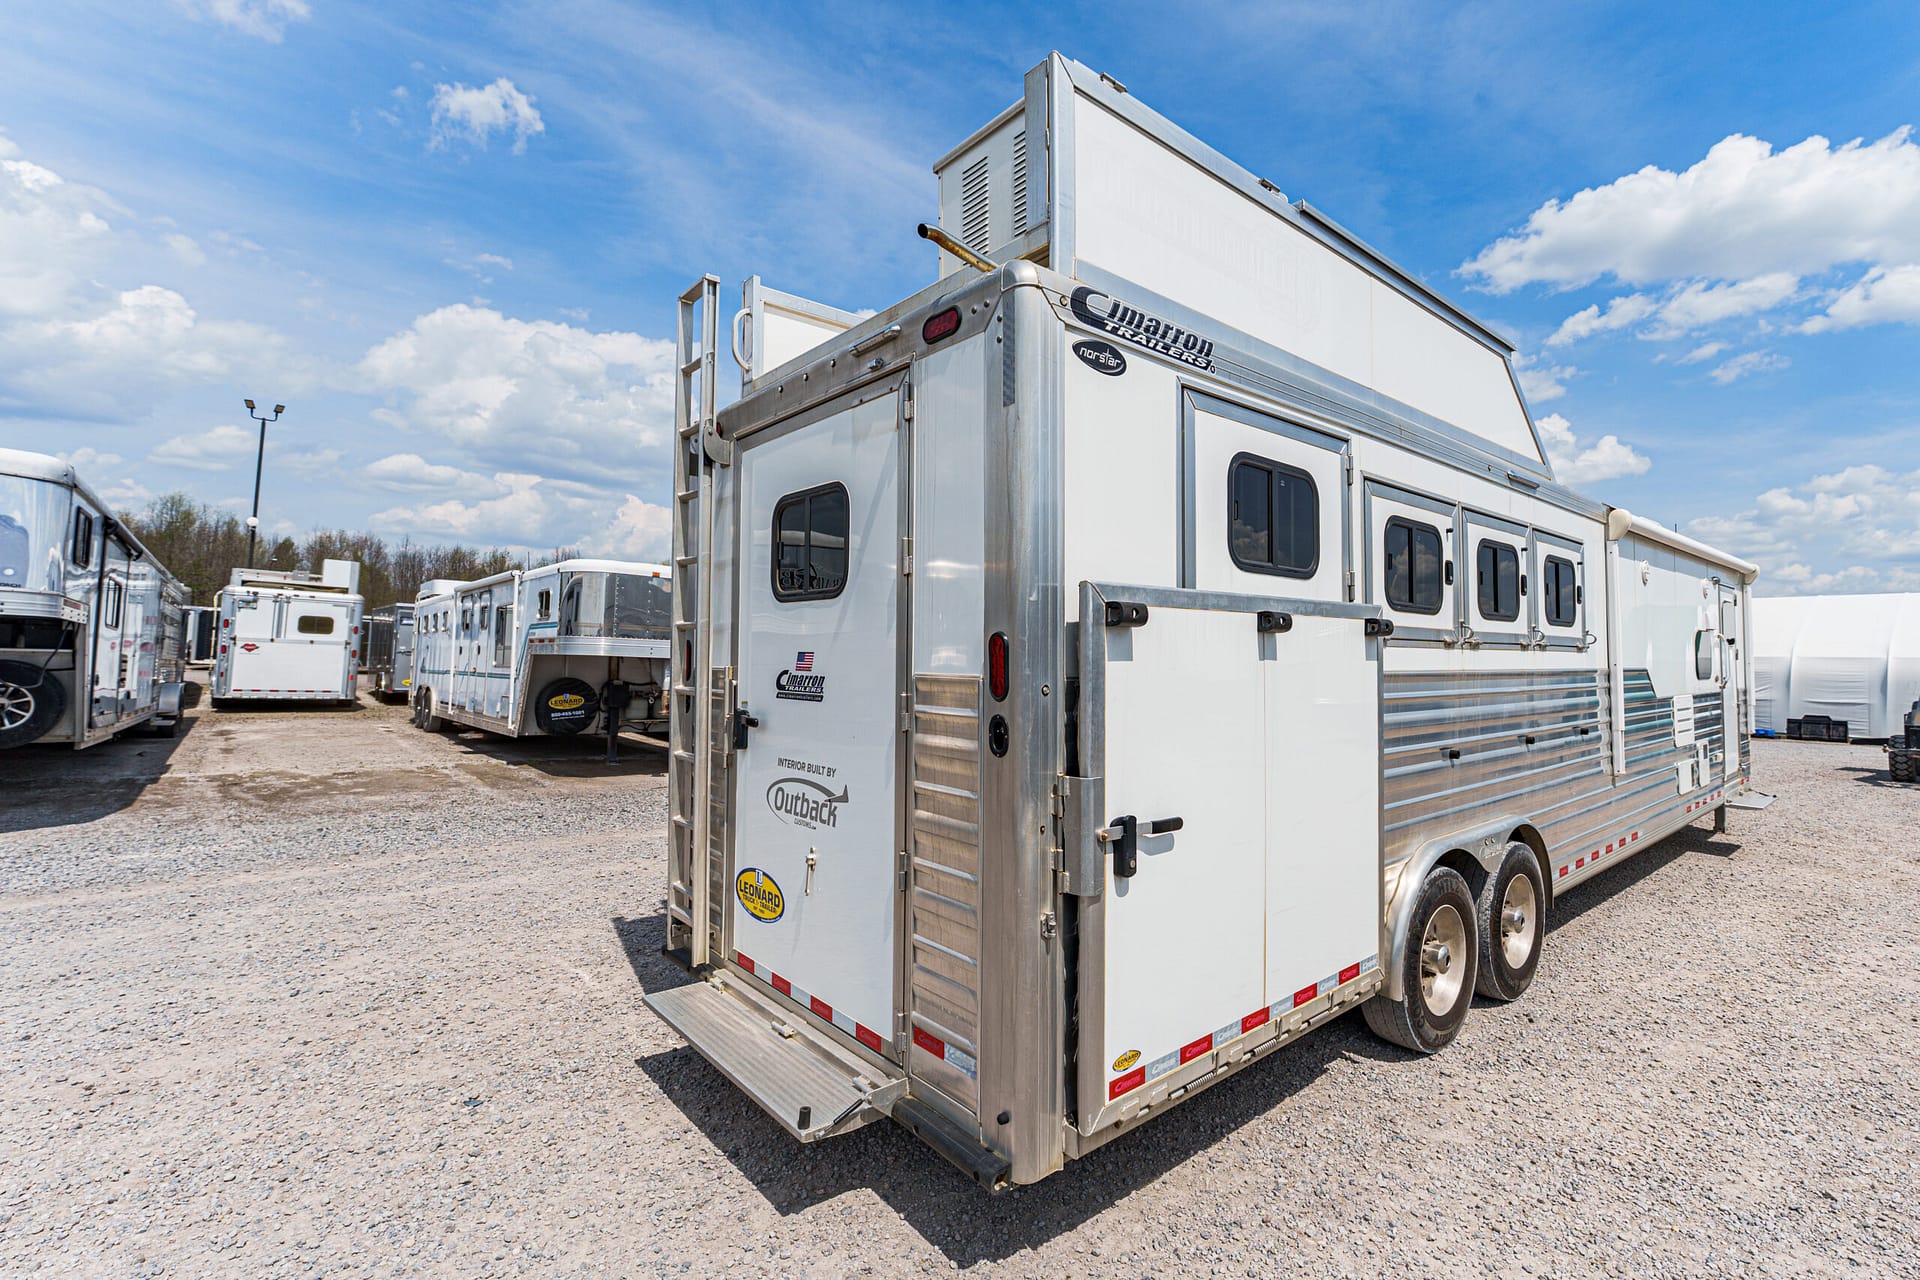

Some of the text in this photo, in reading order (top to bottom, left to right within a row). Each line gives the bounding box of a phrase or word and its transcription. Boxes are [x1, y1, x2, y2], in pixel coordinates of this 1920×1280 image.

[1070, 286, 1214, 358] Cimarron
[1079, 346, 1121, 367] norstar
[1104, 320, 1207, 368] TRAILERS
[776, 669, 825, 690] Cimarron
[778, 757, 837, 778] INTERIOR BUILT BY
[775, 786, 838, 828] Outback
[739, 880, 781, 908] LEONARD
